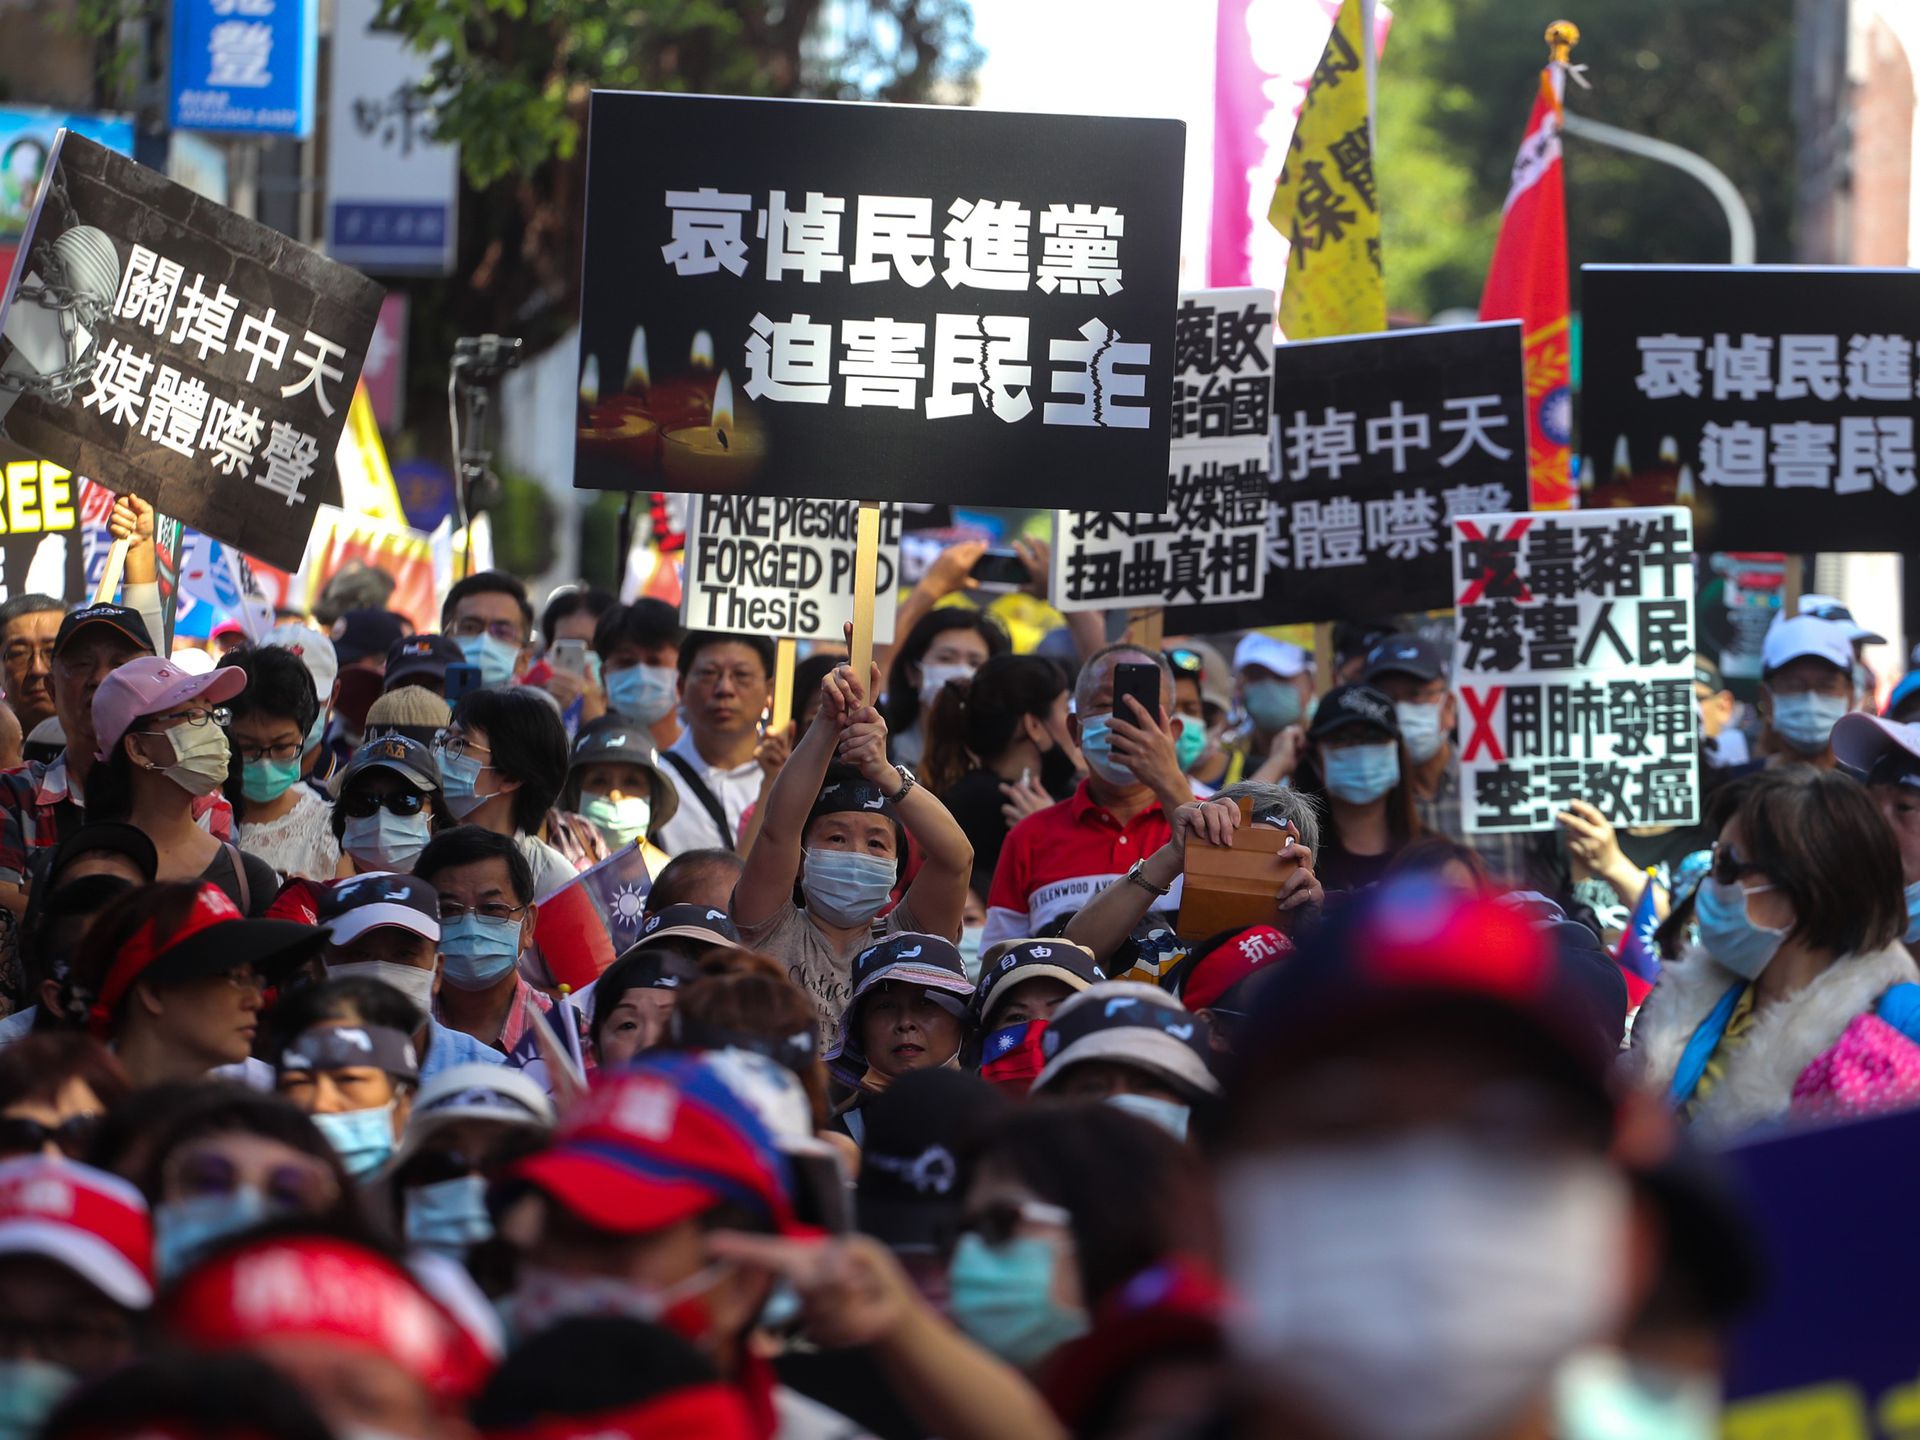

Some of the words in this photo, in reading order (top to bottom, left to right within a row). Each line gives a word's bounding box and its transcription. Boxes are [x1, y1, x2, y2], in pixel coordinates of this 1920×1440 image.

[661, 187, 1124, 296] 哀悼民進黨
[112, 243, 347, 418] 關掉中天
[743, 311, 1151, 429] 迫害民主
[1634, 333, 1920, 400] 哀悼民進
[82, 337, 320, 506] 媒體噤聲
[1266, 394, 1514, 483] 掉中天
[1698, 416, 1918, 495] 迫害民
[700, 494, 771, 537] FAKE
[697, 537, 823, 590] FORGED
[829, 549, 894, 596] PD
[1066, 533, 1260, 602] 扭曲真相
[700, 584, 820, 633] Thesis
